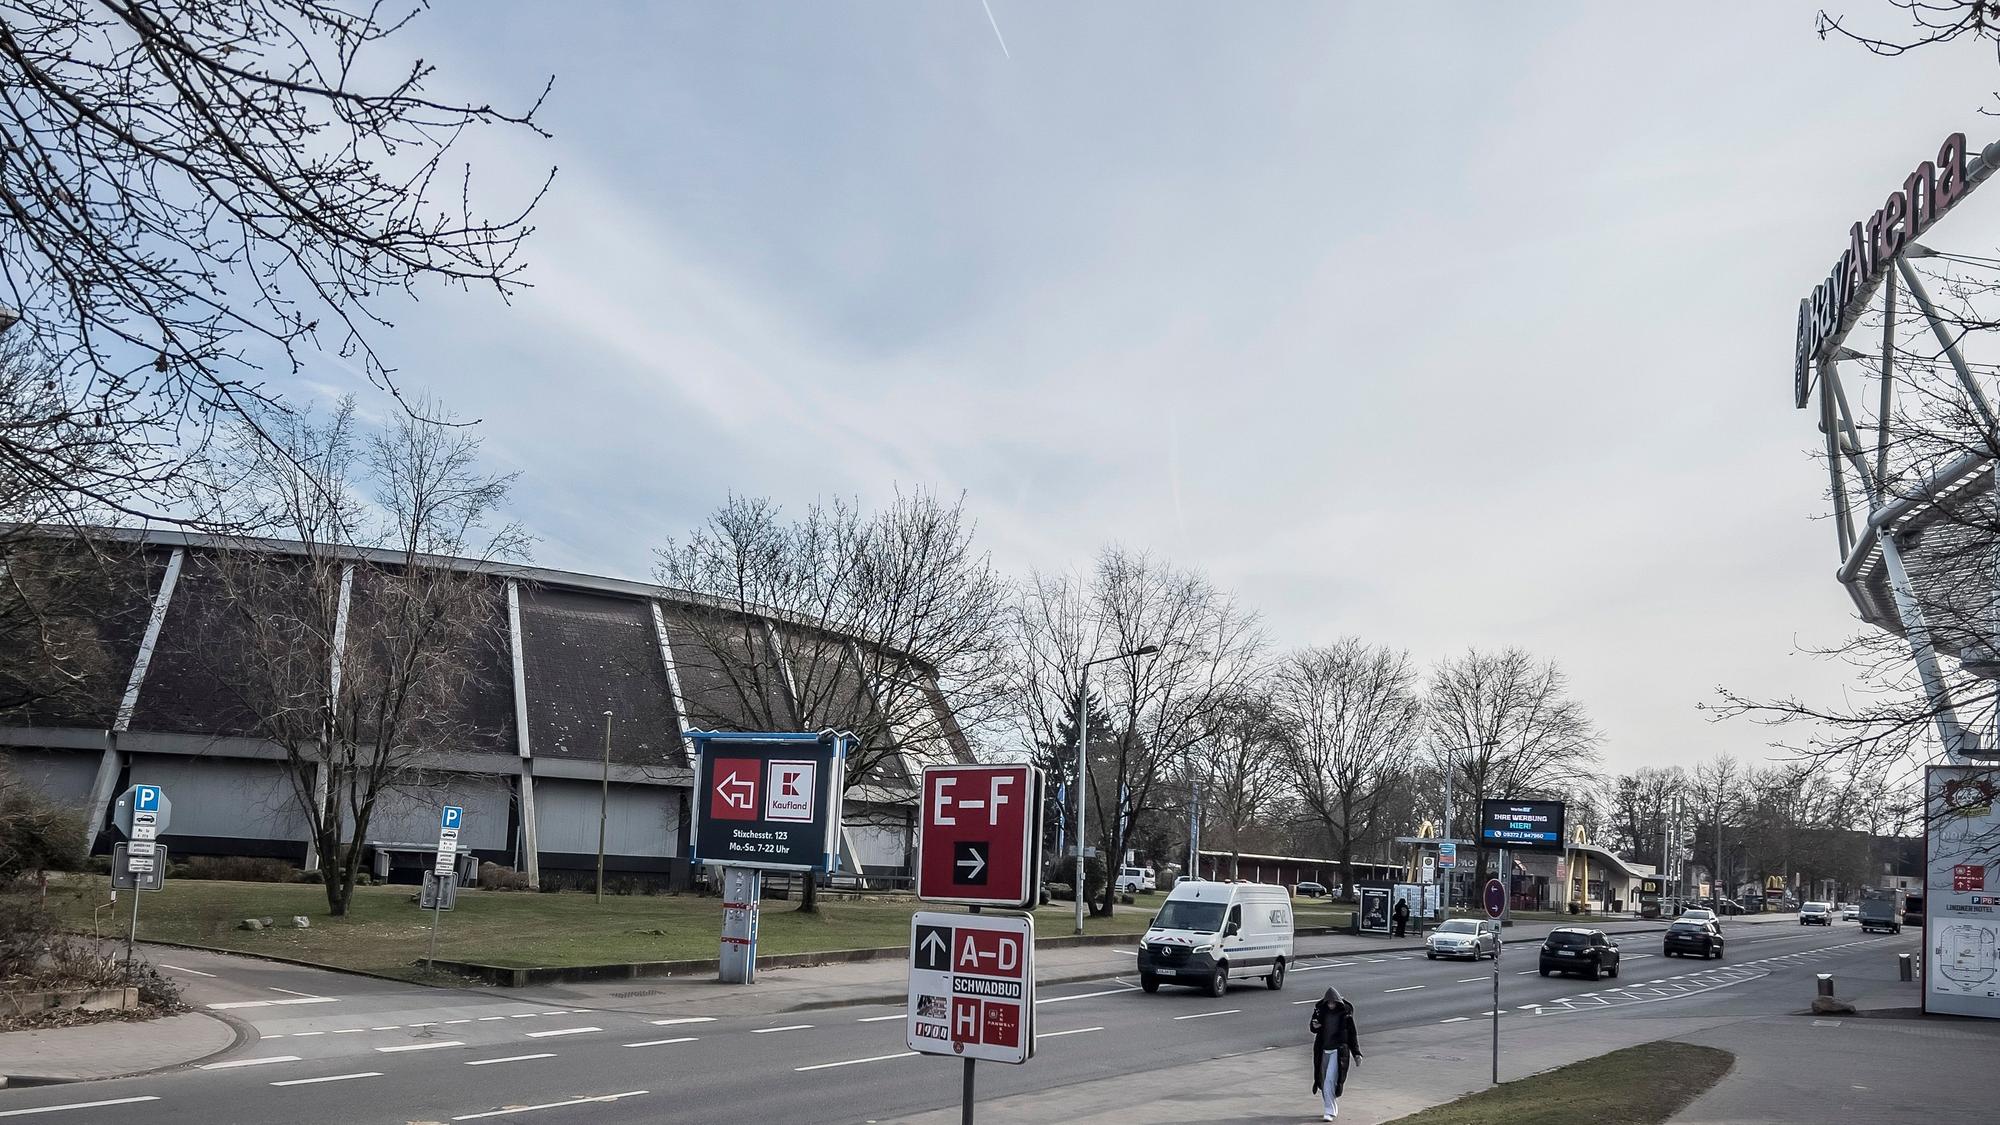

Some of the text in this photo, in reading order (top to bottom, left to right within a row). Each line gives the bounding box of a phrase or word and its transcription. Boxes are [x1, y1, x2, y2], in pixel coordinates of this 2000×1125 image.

[1808, 132, 1969, 360] BayArena
[782, 772, 801, 796] K
[140, 788, 154, 808] P
[772, 800, 808, 811] Kaufland
[446, 809, 457, 826] P
[733, 829, 788, 840] Stixchesstr. 123
[729, 842, 790, 854] Mo.-Sa. 7-22 Uhr
[954, 979, 1020, 997] SCHWADBUD
[956, 1003, 976, 1037] H
[916, 1023, 948, 1040] 1904
